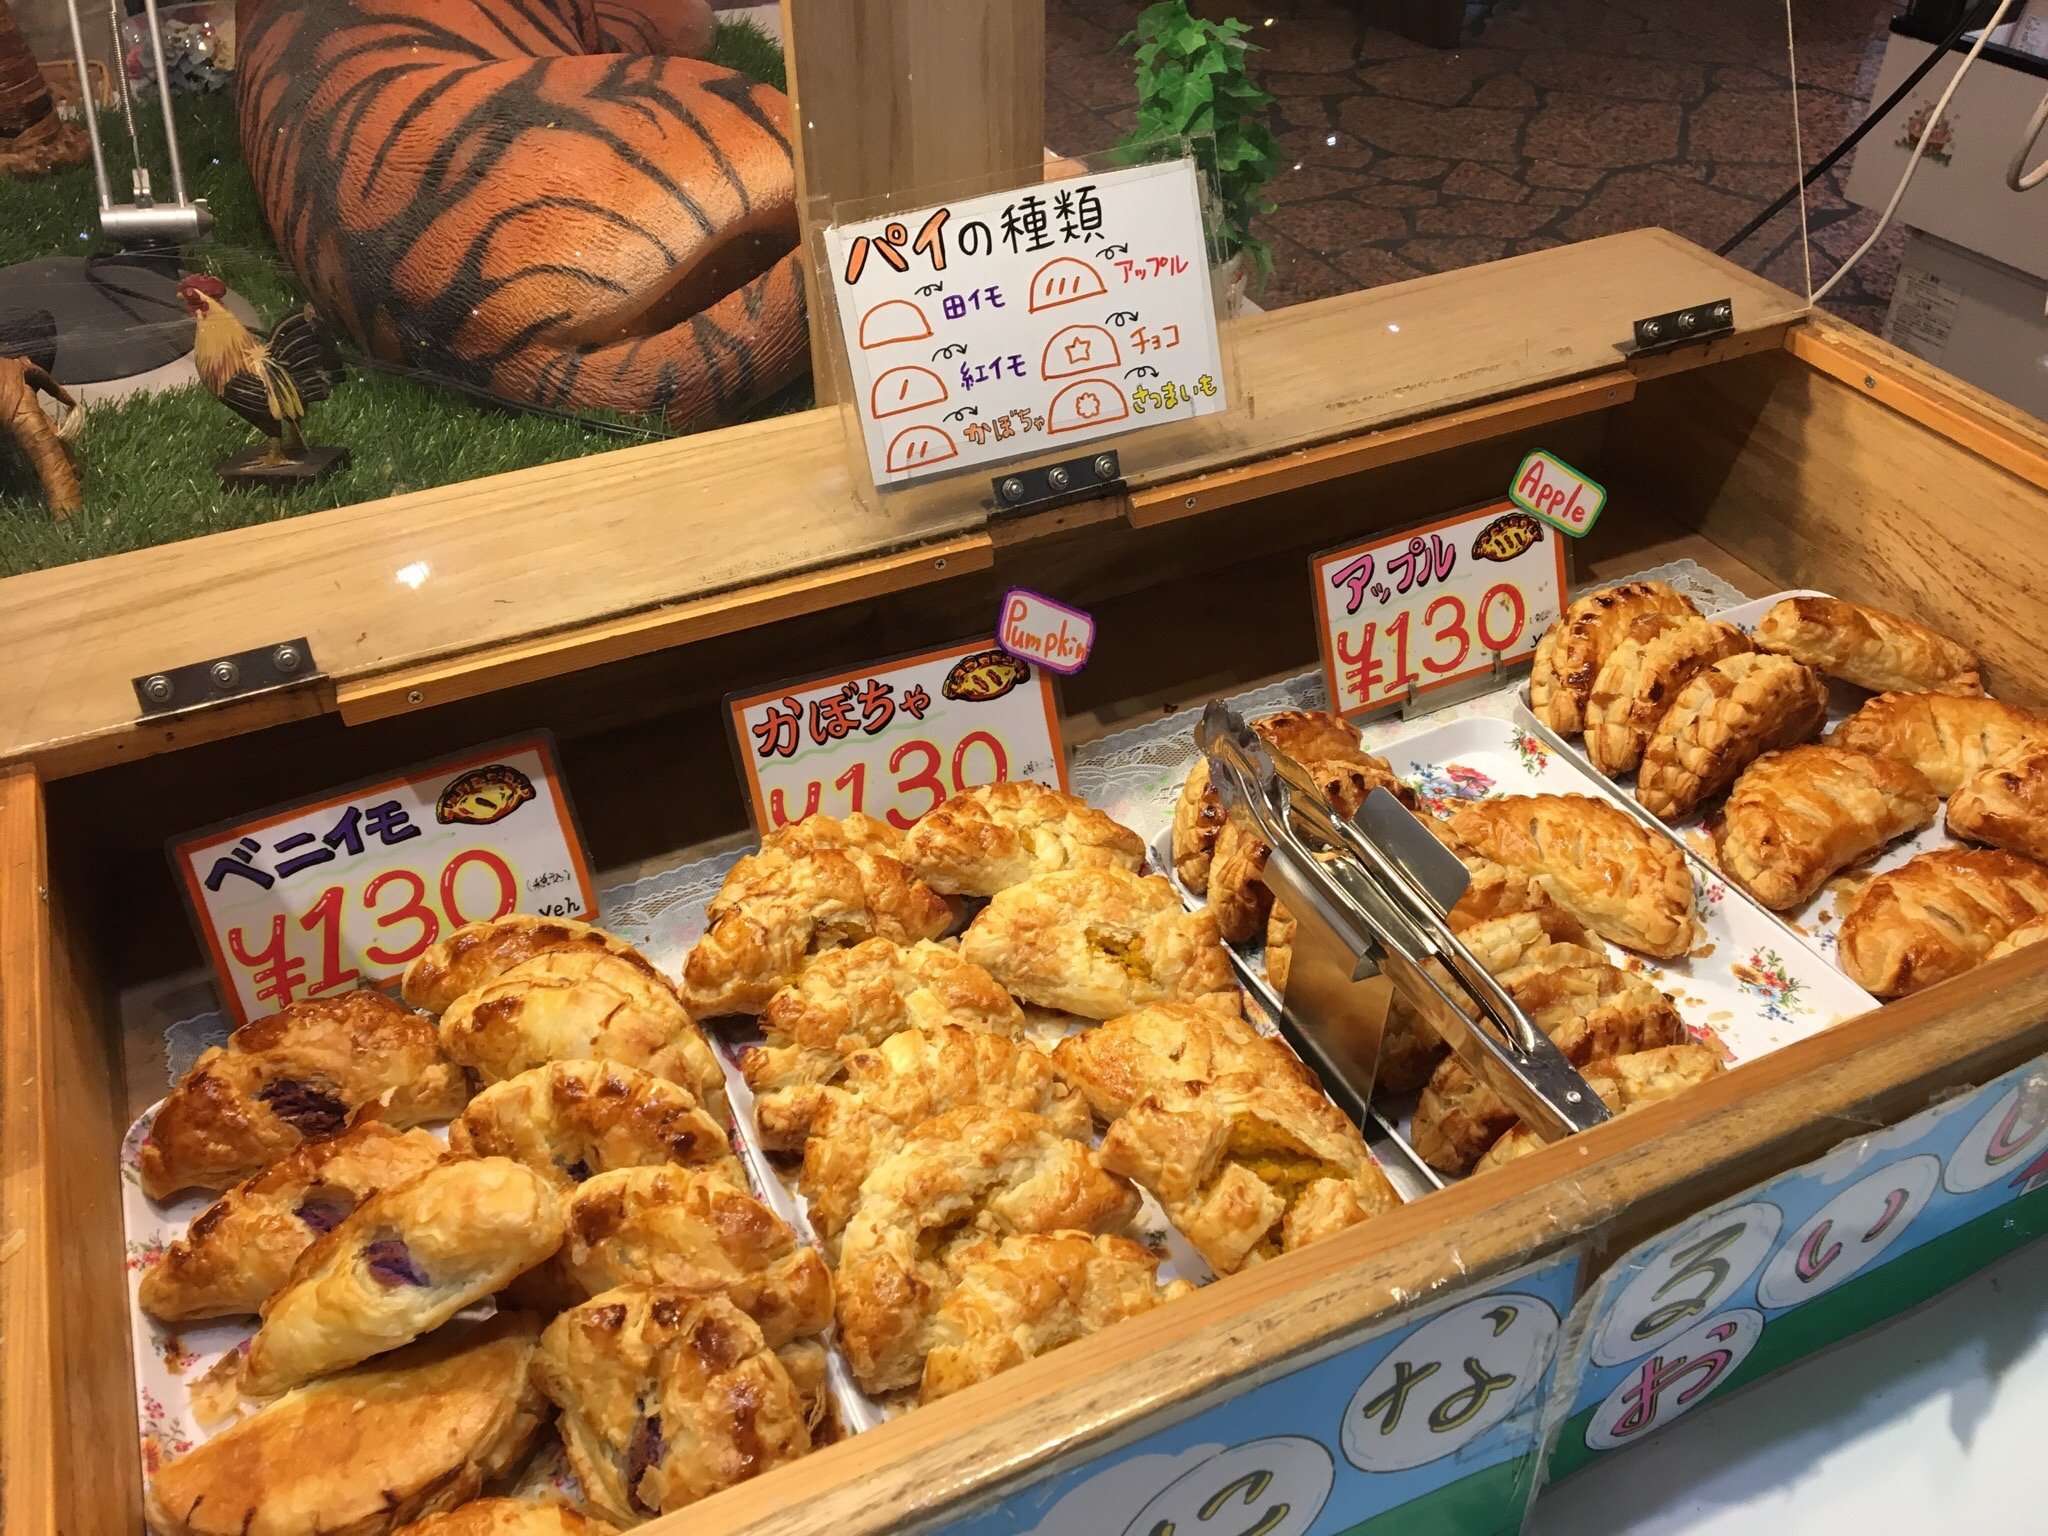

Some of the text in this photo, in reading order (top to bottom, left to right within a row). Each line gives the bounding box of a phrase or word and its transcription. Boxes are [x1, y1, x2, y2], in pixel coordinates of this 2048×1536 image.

[845, 185, 1105, 285] パイの種類
[1113, 254, 1189, 284] アップル
[943, 285, 1006, 320] 田イモ
[1130, 325, 1181, 354] チョコ
[959, 354, 1026, 391] 紅イモ
[1132, 374, 1218, 414] さつまいも
[963, 408, 1046, 445] かぼちゃ
[1518, 460, 1586, 523] Apple
[1331, 534, 1456, 615] アップル
[1005, 599, 1087, 660] Pumpkin
[1336, 582, 1526, 703] ¥130
[753, 678, 932, 759] かぼちゃ
[204, 800, 422, 893] ベニイモ
[228, 849, 518, 1010] ¥130
